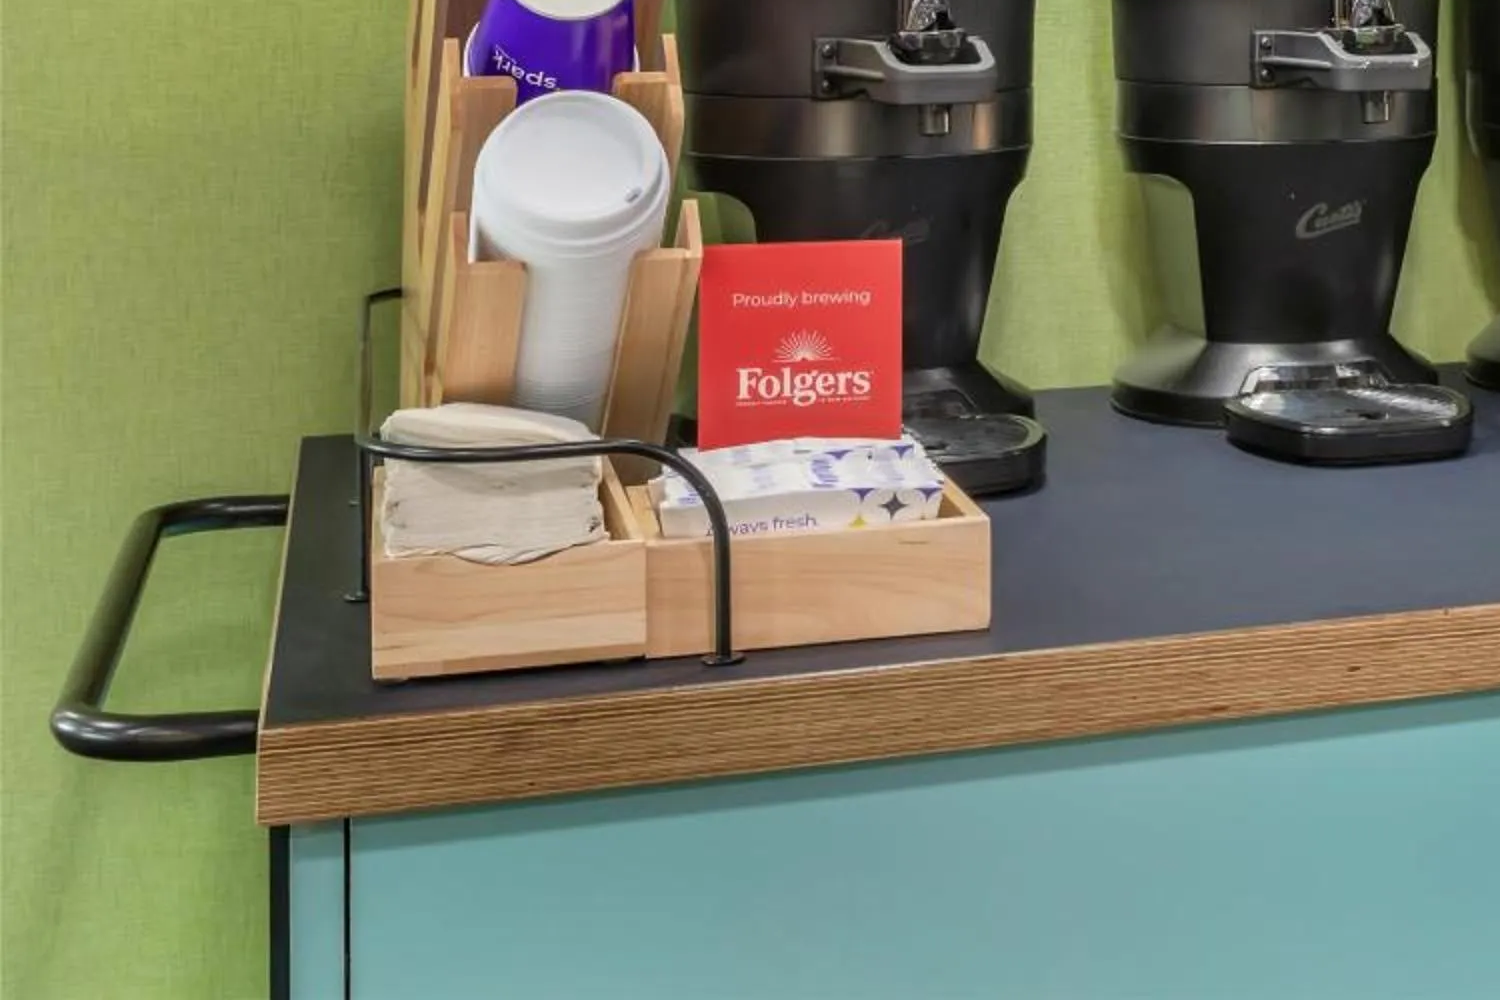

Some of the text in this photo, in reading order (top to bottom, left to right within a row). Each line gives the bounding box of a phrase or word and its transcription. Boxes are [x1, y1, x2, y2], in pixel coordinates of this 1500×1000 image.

[493, 49, 557, 89] spark
[733, 290, 871, 309] Proudly brewing
[736, 367, 871, 407] Folgers
